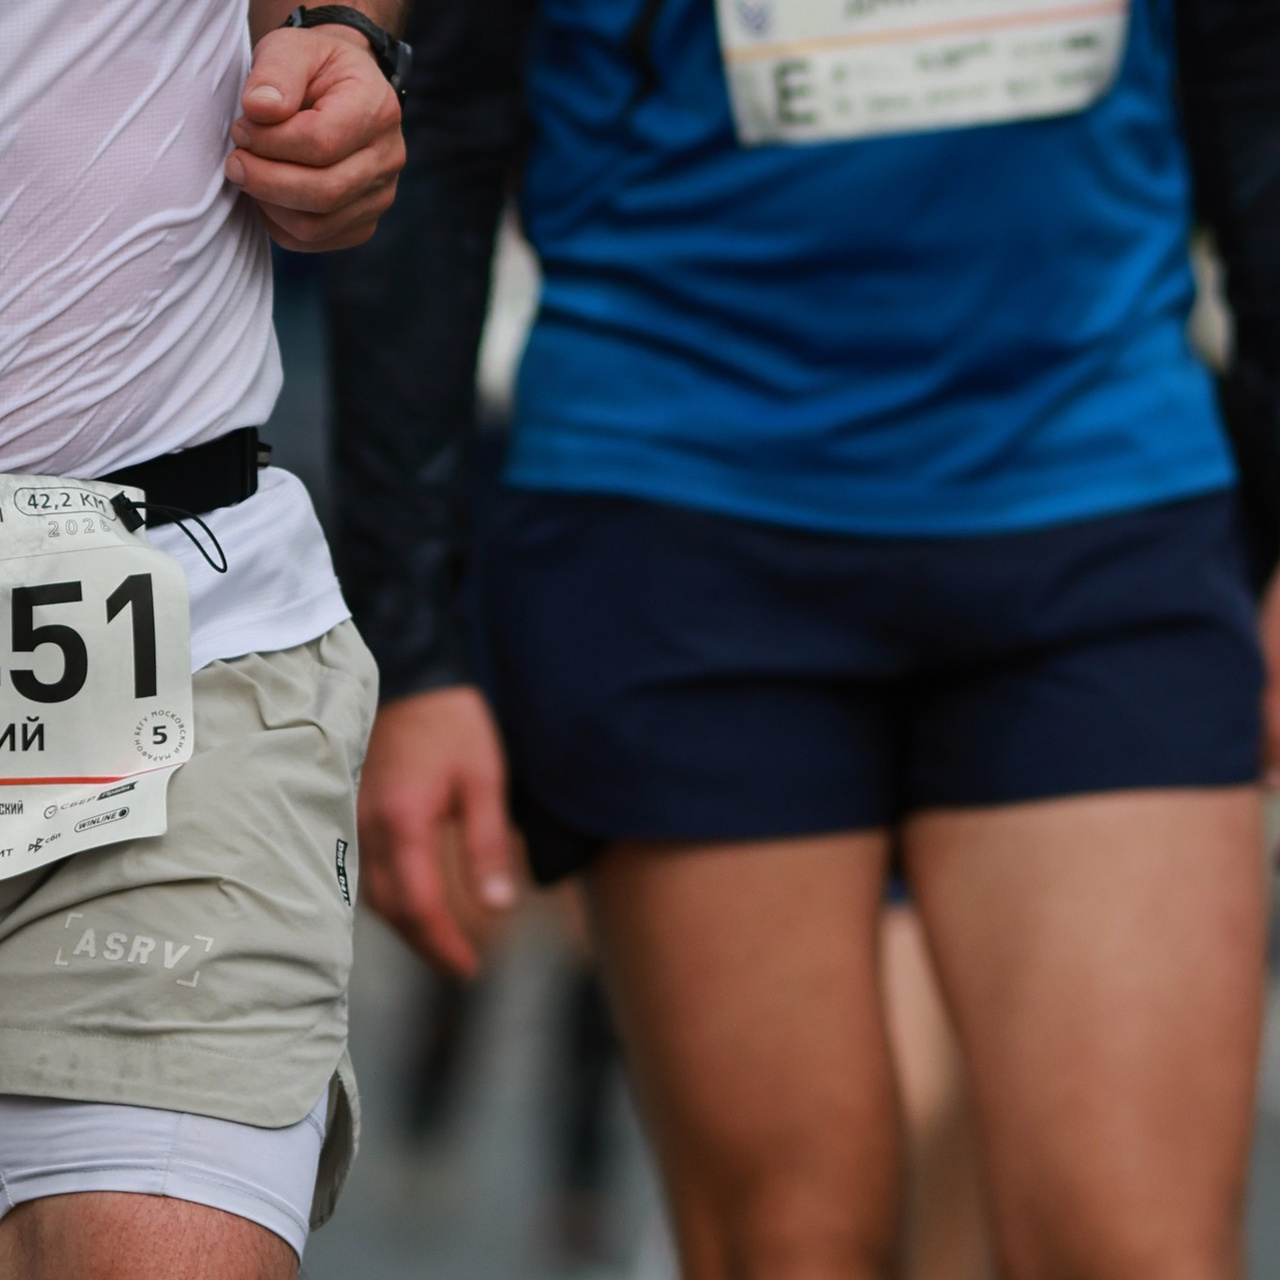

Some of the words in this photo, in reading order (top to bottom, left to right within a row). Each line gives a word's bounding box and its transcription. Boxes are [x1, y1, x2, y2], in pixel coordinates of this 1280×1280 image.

[775, 60, 817, 124] E
[27, 492, 72, 510] 42,2
[152, 725, 168, 745] 5
[78, 811, 118, 830] WINLINE
[72, 928, 191, 970] ASRV
